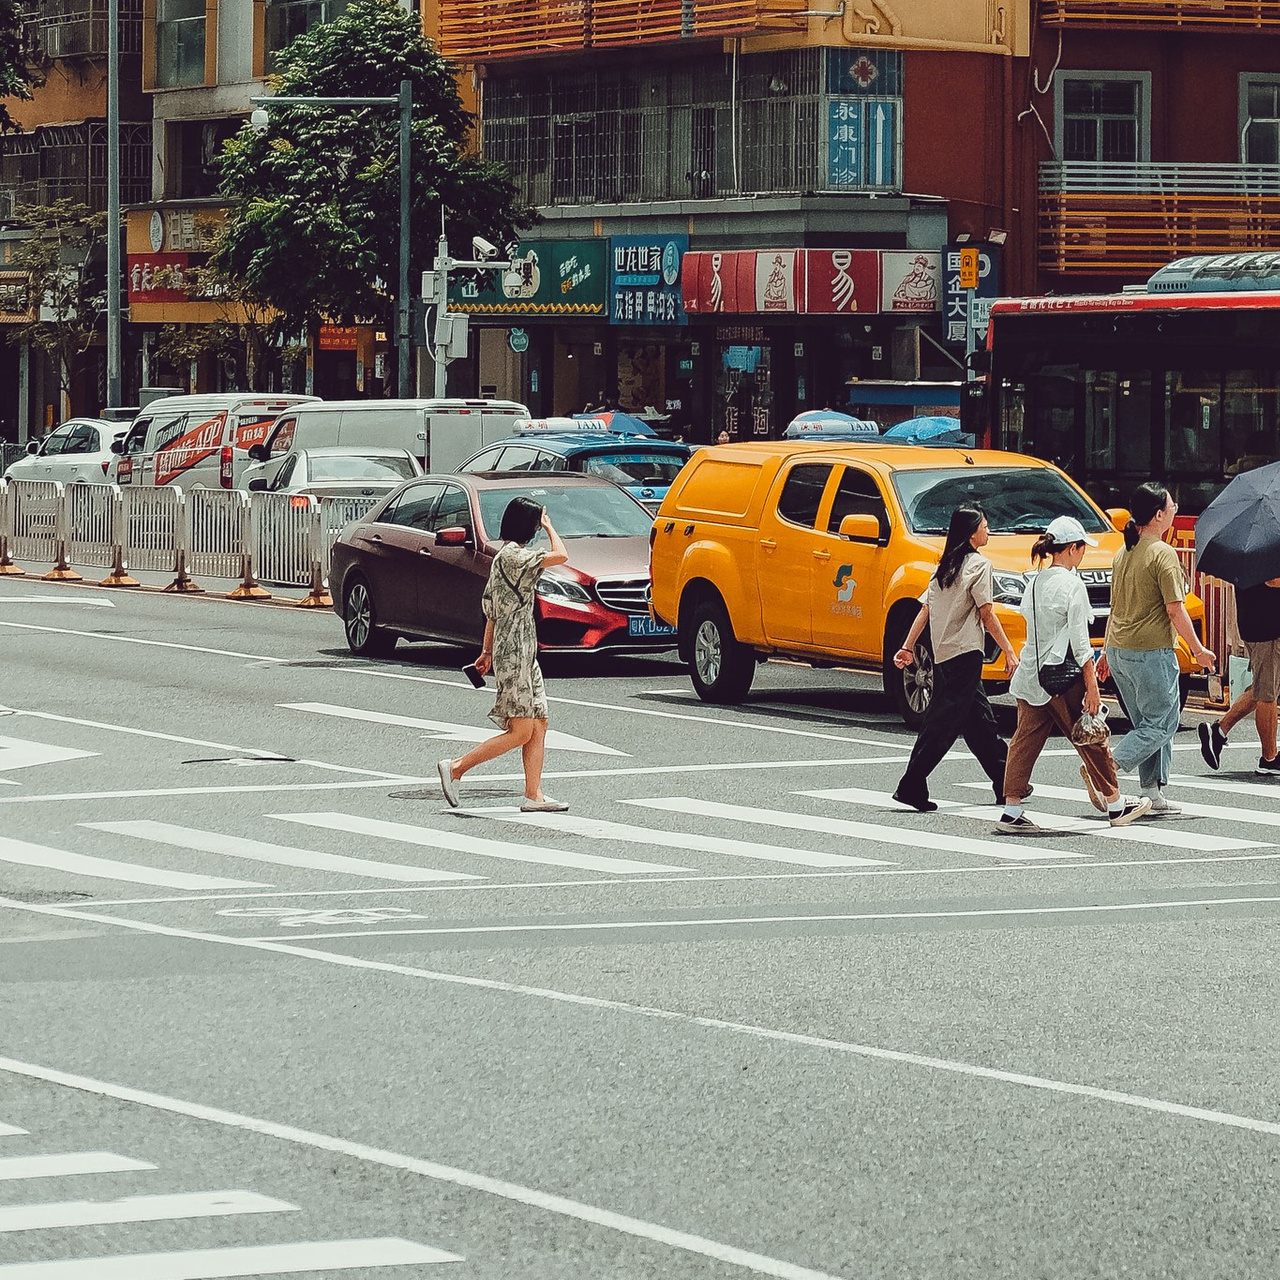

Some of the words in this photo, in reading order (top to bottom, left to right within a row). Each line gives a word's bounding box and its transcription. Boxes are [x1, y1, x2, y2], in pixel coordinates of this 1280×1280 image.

[832, 102, 858, 184] 永康门诊
[615, 291, 643, 321] 灰指甲
[576, 420, 604, 430] TAXI
[848, 422, 875, 431] TAXI
